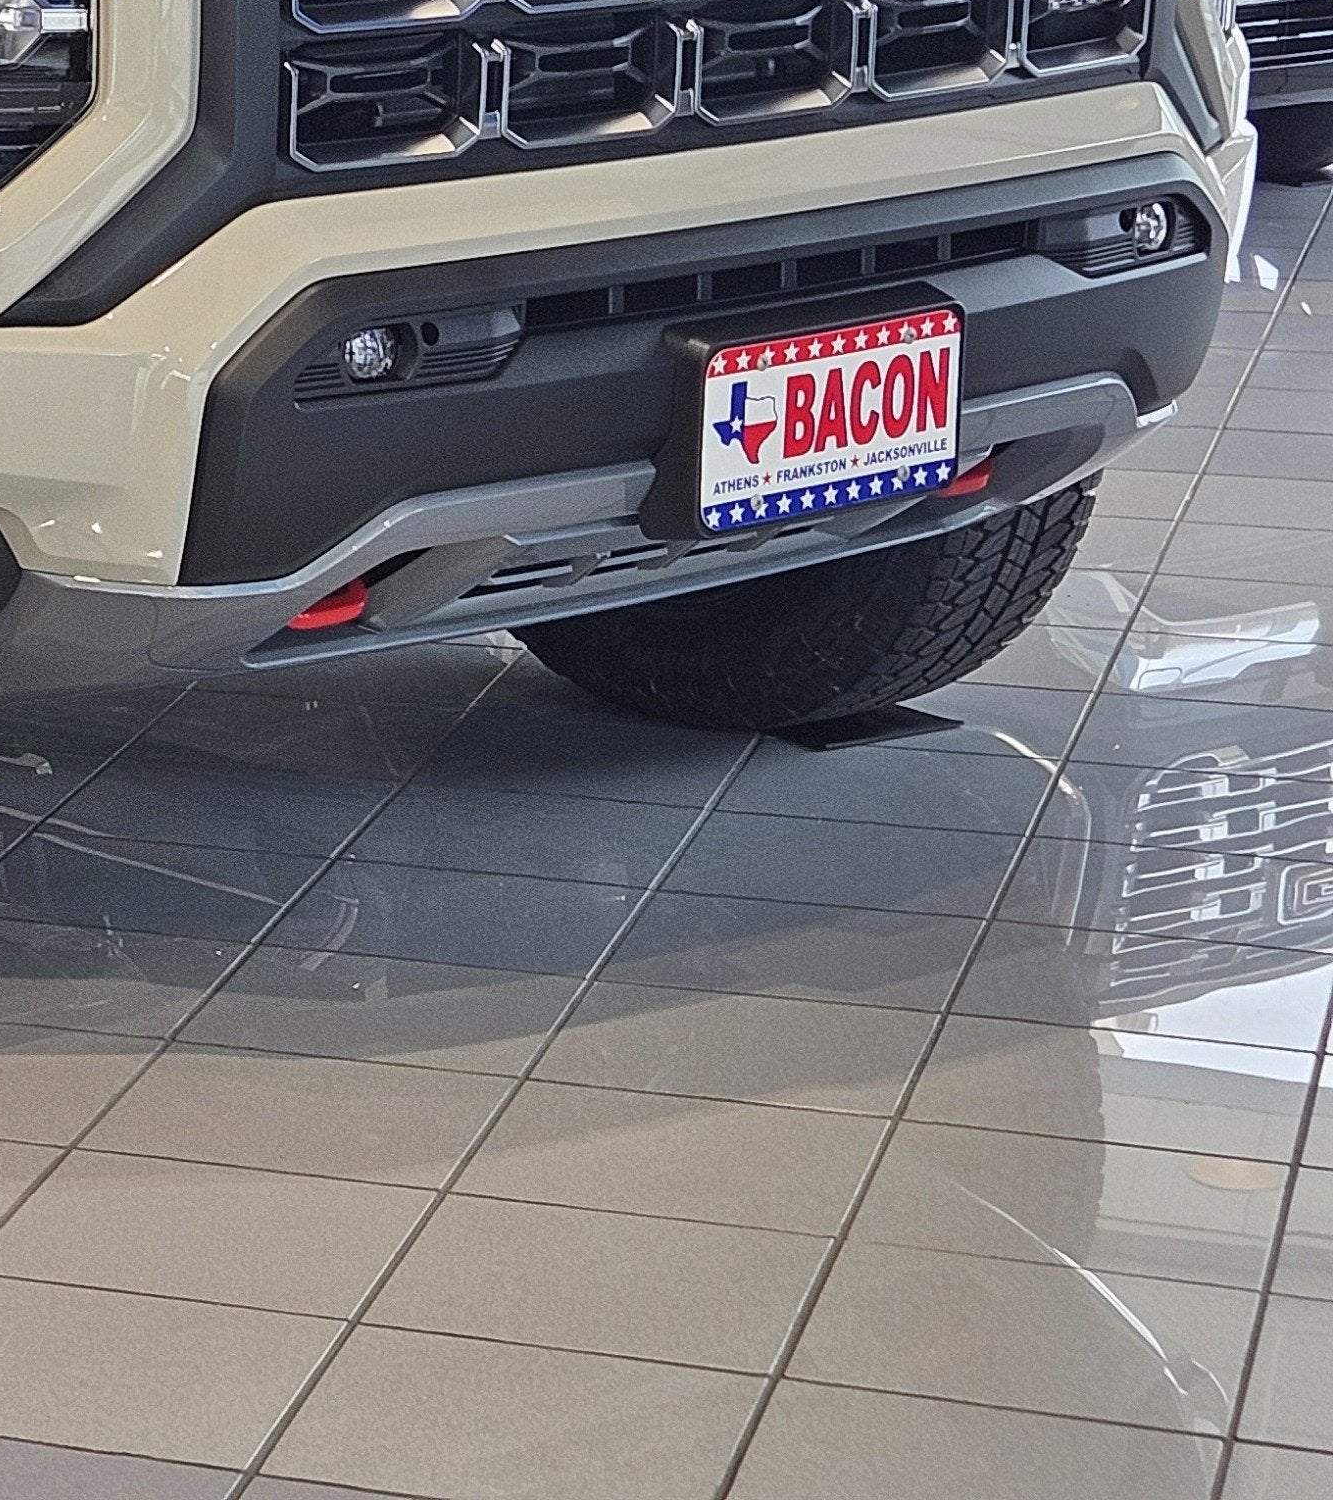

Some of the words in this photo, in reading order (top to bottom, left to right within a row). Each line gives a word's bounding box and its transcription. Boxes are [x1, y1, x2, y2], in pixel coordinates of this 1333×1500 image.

[782, 346, 952, 460] BACON
[712, 473, 760, 496] ATHENS
[776, 457, 847, 483] FRANKSTON
[863, 437, 948, 467] JACKSONVILLE
